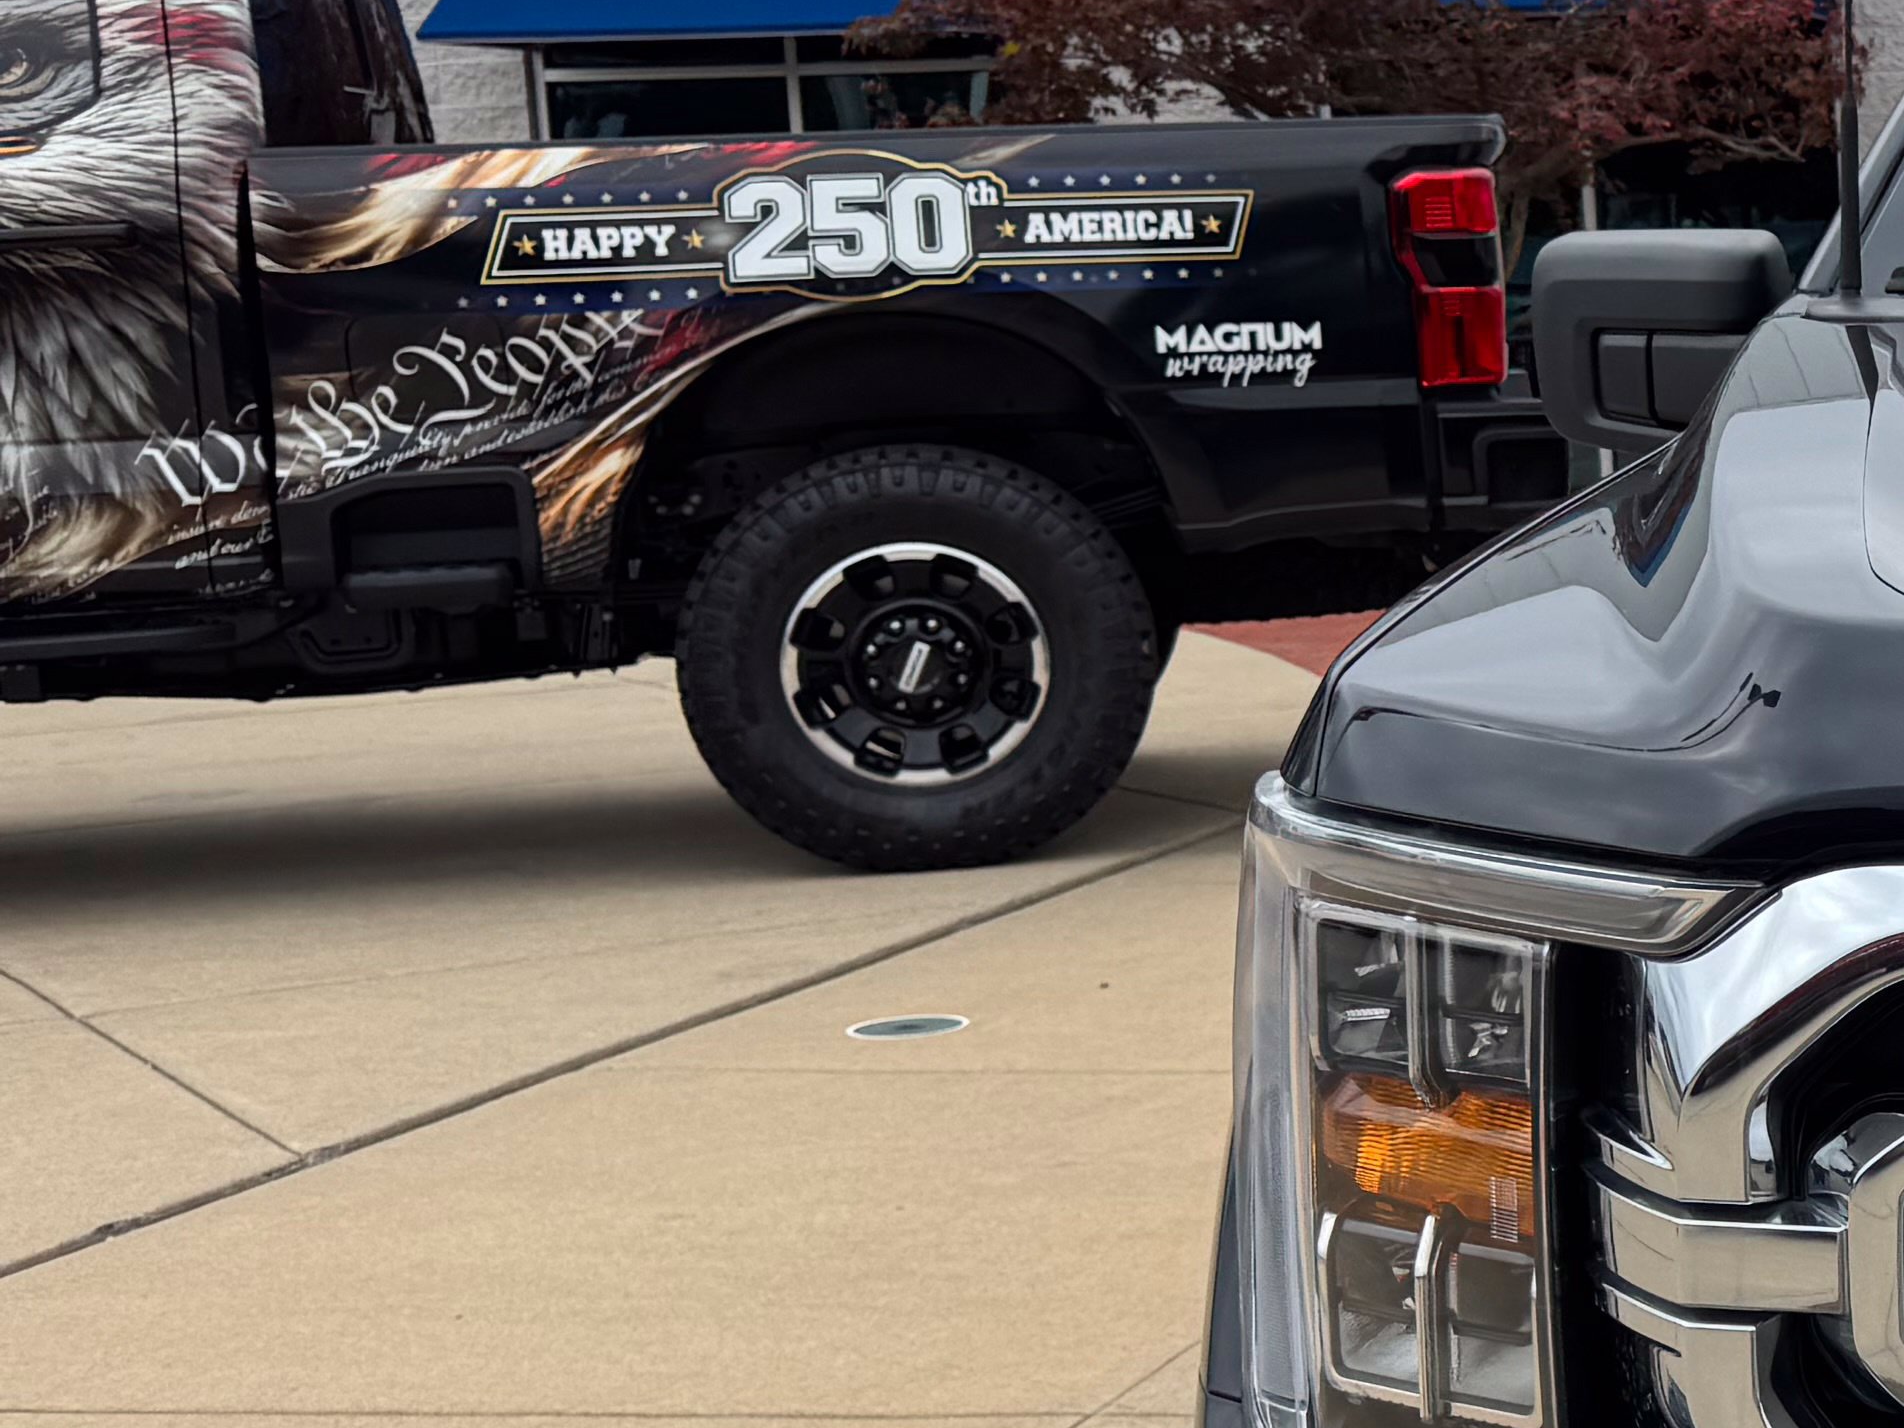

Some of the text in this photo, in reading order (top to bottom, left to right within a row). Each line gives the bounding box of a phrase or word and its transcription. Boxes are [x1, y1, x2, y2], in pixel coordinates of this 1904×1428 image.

[542, 223, 674, 261] HAPPY
[1024, 211, 1194, 245] AMERICA!
[1154, 321, 1323, 354] MAGNUM
[1165, 346, 1317, 388] wrapping
